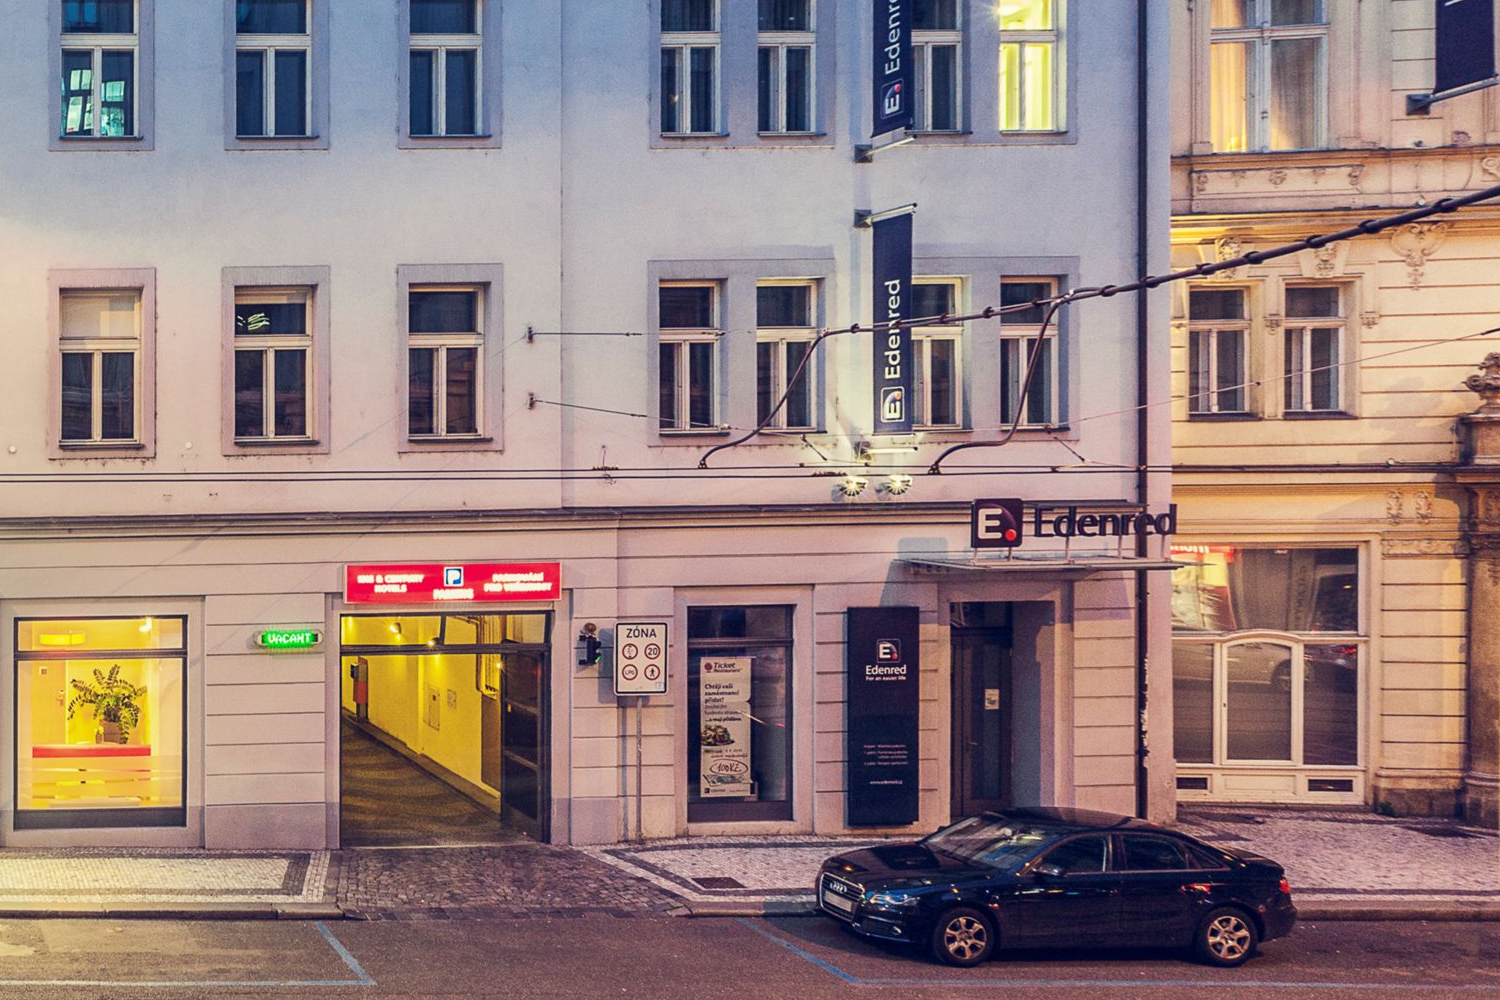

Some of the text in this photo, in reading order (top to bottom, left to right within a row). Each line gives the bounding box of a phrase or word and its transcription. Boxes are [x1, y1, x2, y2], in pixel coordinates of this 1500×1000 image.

[884, 278, 901, 380] Edenred
[1034, 503, 1178, 538] Edenred
[625, 625, 658, 639] ZÓNA
[267, 633, 312, 644] VACANT
[647, 647, 659, 656] 20
[865, 664, 907, 675] Edenred
